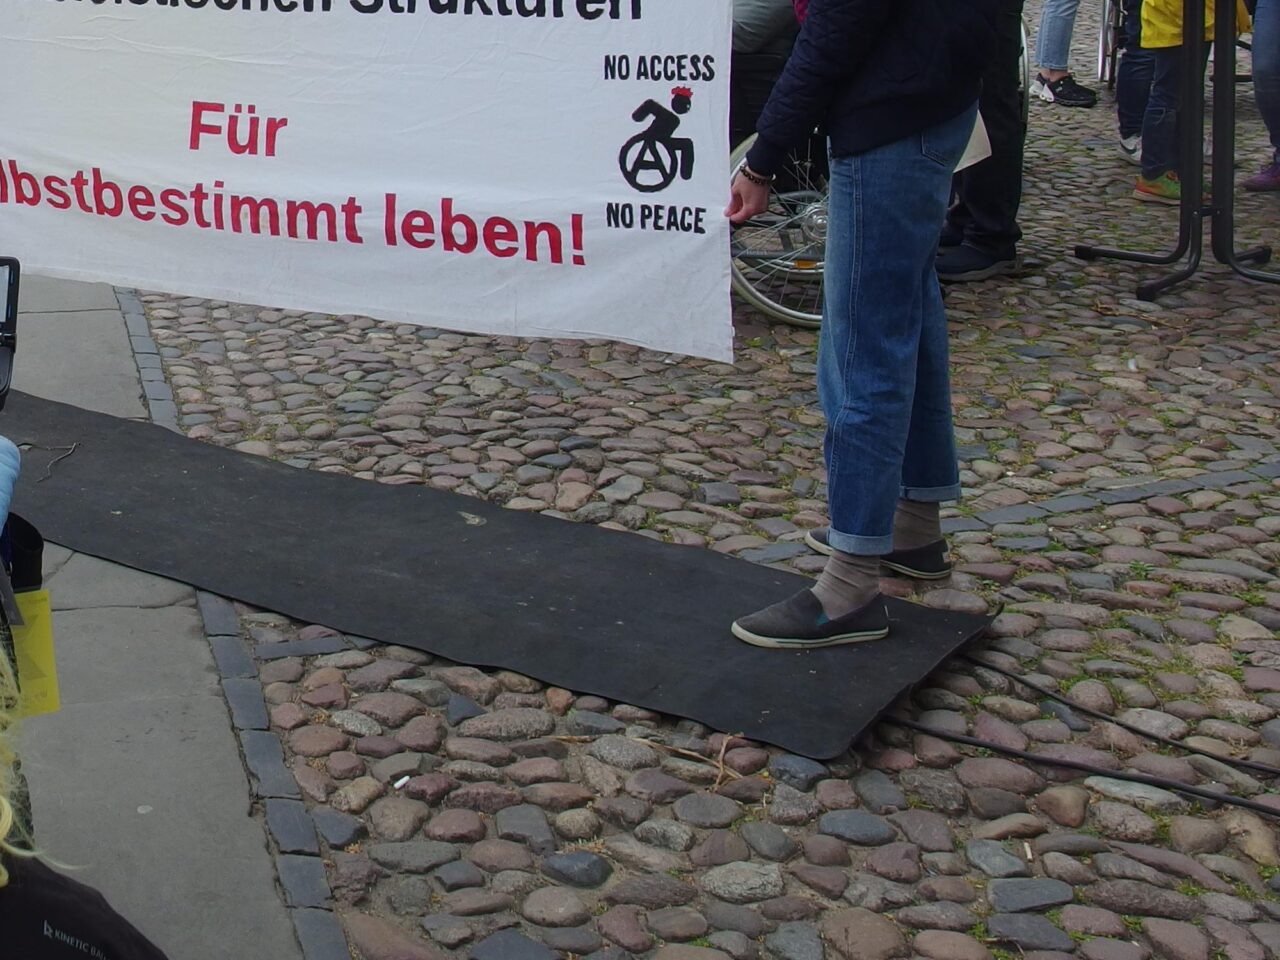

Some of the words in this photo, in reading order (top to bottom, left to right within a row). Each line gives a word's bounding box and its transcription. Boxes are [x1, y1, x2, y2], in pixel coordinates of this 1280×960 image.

[604, 55, 630, 81] NO
[636, 54, 715, 82] ACCESS
[189, 101, 288, 157] Für
[384, 192, 586, 266] leben!
[606, 202, 634, 229] NO
[640, 203, 706, 234] PEACE
[54, 928, 89, 953] KINETIC
